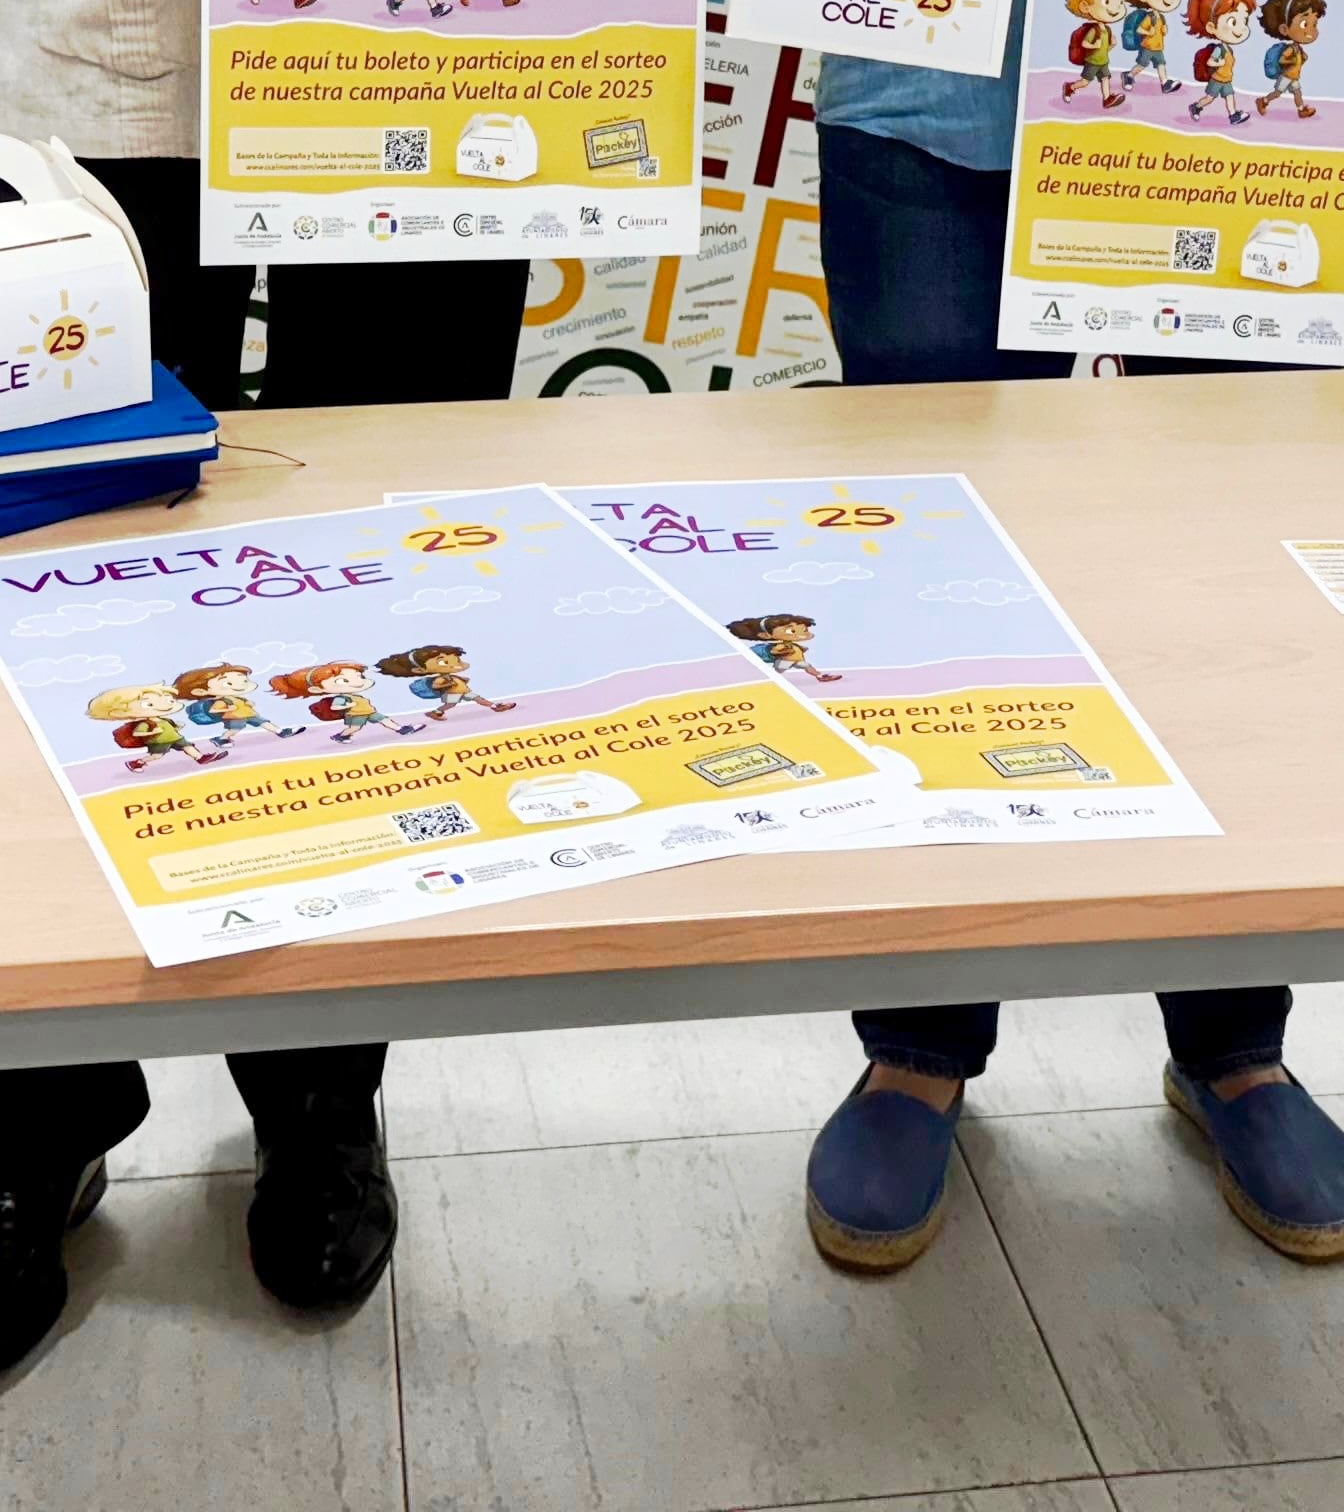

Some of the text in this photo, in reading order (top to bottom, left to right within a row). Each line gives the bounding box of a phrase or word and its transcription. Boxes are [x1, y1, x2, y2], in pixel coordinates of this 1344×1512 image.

[822, 1, 899, 29] COLE
[230, 49, 667, 76] Pide aquí tu boleto y participa en el sorteo
[229, 78, 654, 105] de nuestra campaña Vuelta al Cole 2025
[1039, 144, 1083, 167] Pide
[1087, 148, 1134, 173] aquí
[1136, 154, 1157, 171] tu
[1162, 153, 1225, 174] boleto
[1229, 162, 1241, 180] y
[1244, 159, 1333, 183] participa
[1036, 173, 1062, 194] de
[1065, 179, 1142, 199] nuestra
[1146, 183, 1237, 206] campaña
[1242, 186, 1306, 209] Vuelta
[1309, 189, 1329, 210] al
[408, 525, 498, 553] 25
[1, 545, 278, 594] VUELTA
[249, 553, 331, 578] AL
[191, 561, 394, 607] COLE
[983, 699, 1075, 714] sorteo
[911, 717, 1068, 734] Cole 2025
[123, 700, 756, 820] Pide aquí tu boleto participa en el sorteo
[134, 718, 756, 841] de nuestra campaña Vuelta al Cole 2025
